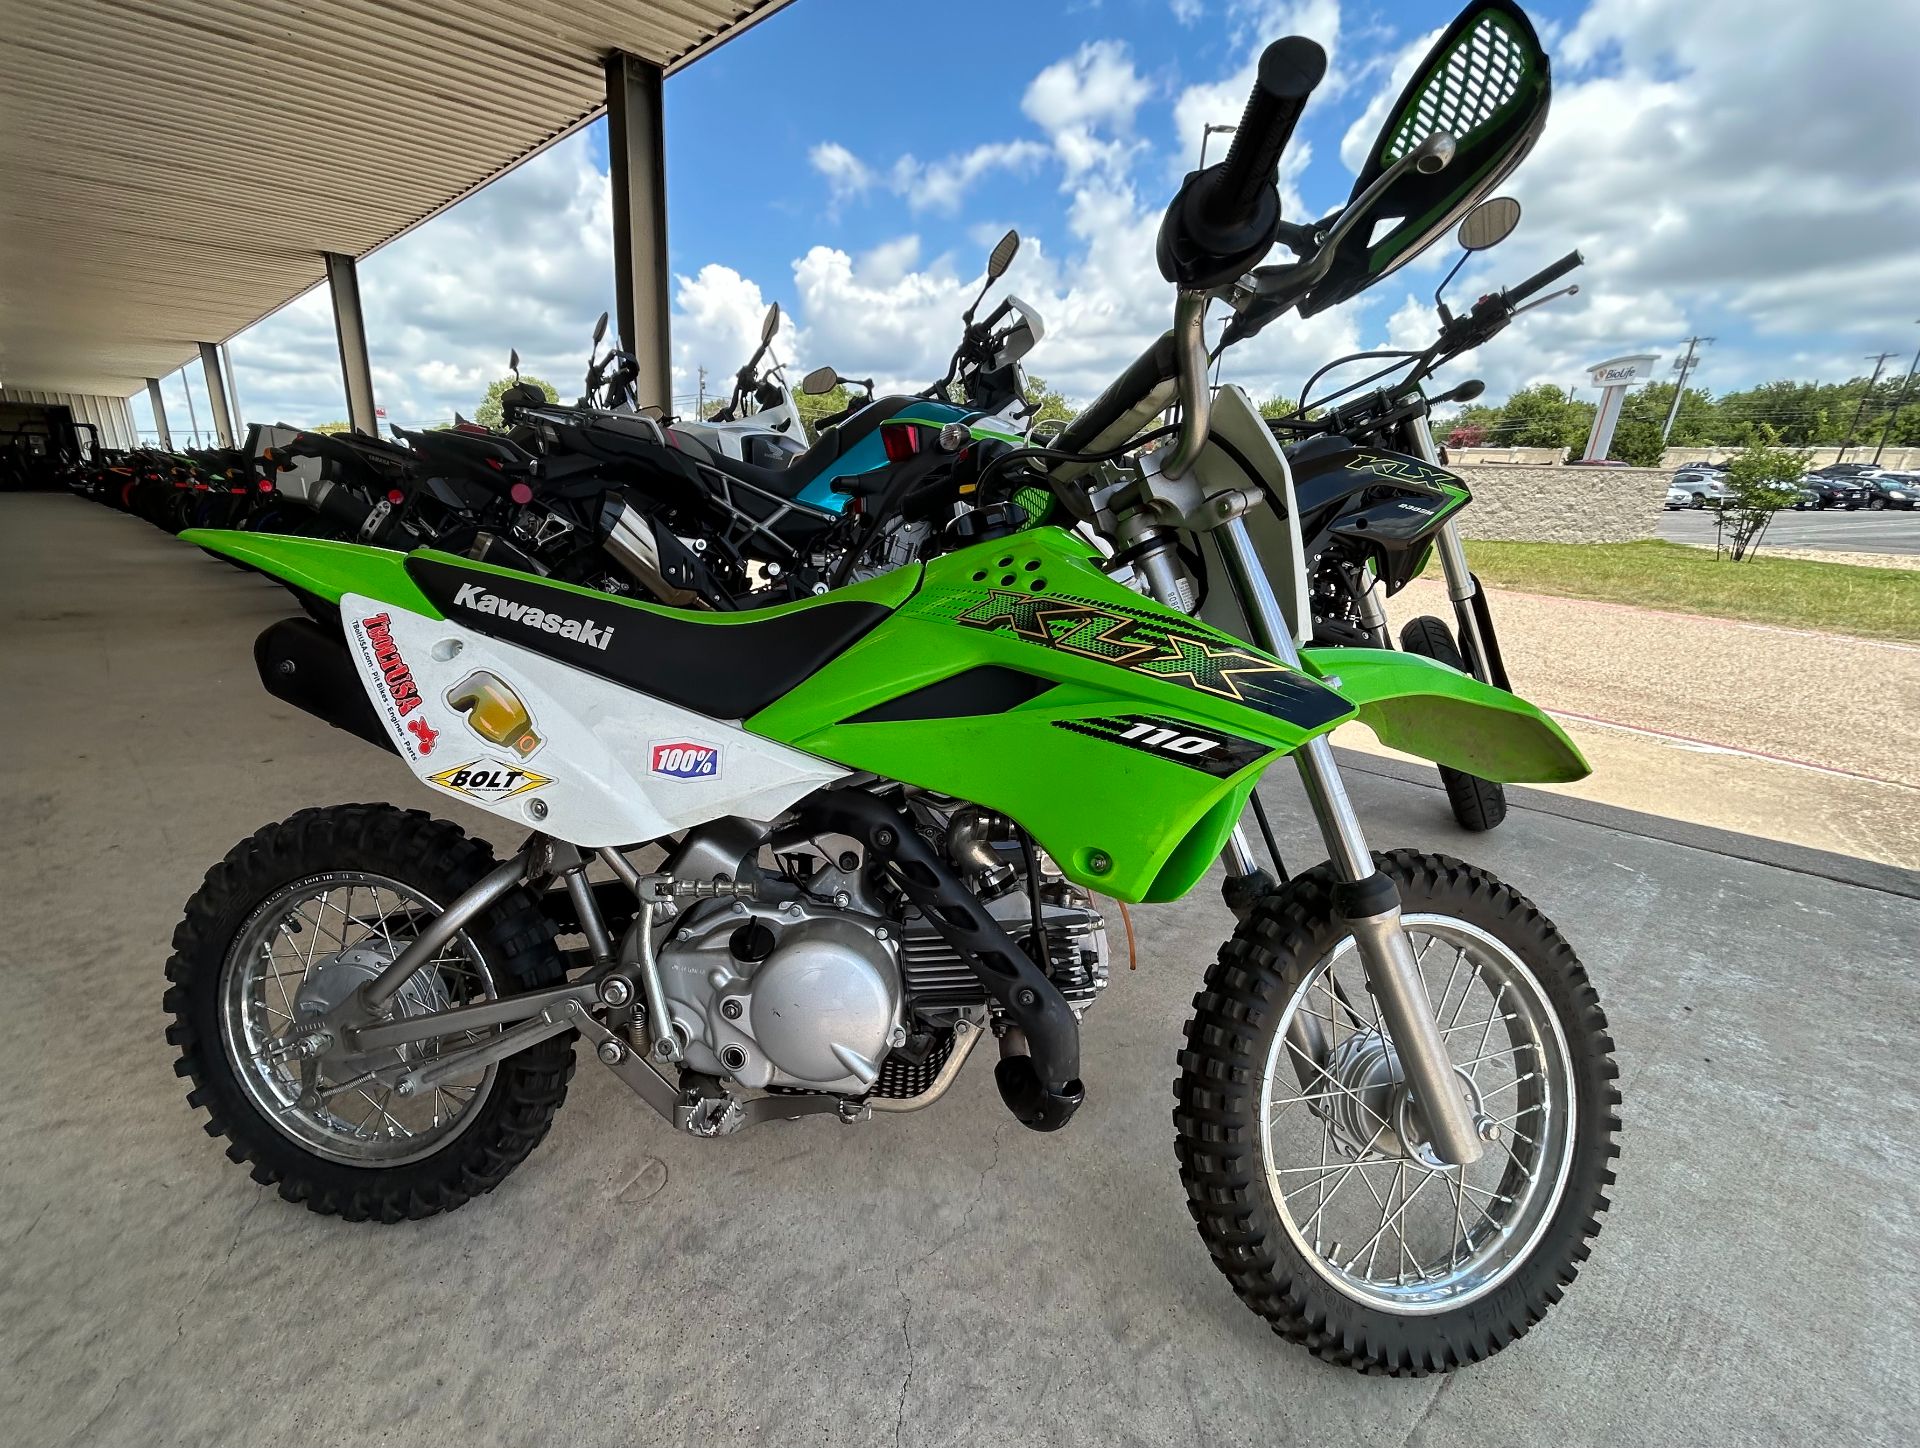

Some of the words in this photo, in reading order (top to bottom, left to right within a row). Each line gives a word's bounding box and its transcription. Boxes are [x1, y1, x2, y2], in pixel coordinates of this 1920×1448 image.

[1606, 366, 1636, 379] BioLife
[1344, 454, 1457, 492] KLX
[453, 583, 615, 651] Kawasaki
[955, 588, 1292, 701] KLX
[371, 671, 379, 682] Pit
[376, 682, 389, 703] Bikes
[387, 706, 405, 737] Engines
[403, 740, 418, 761] Parts
[1118, 722, 1220, 755] 110
[450, 770, 523, 788] BOLT
[657, 750, 712, 774] 100%
